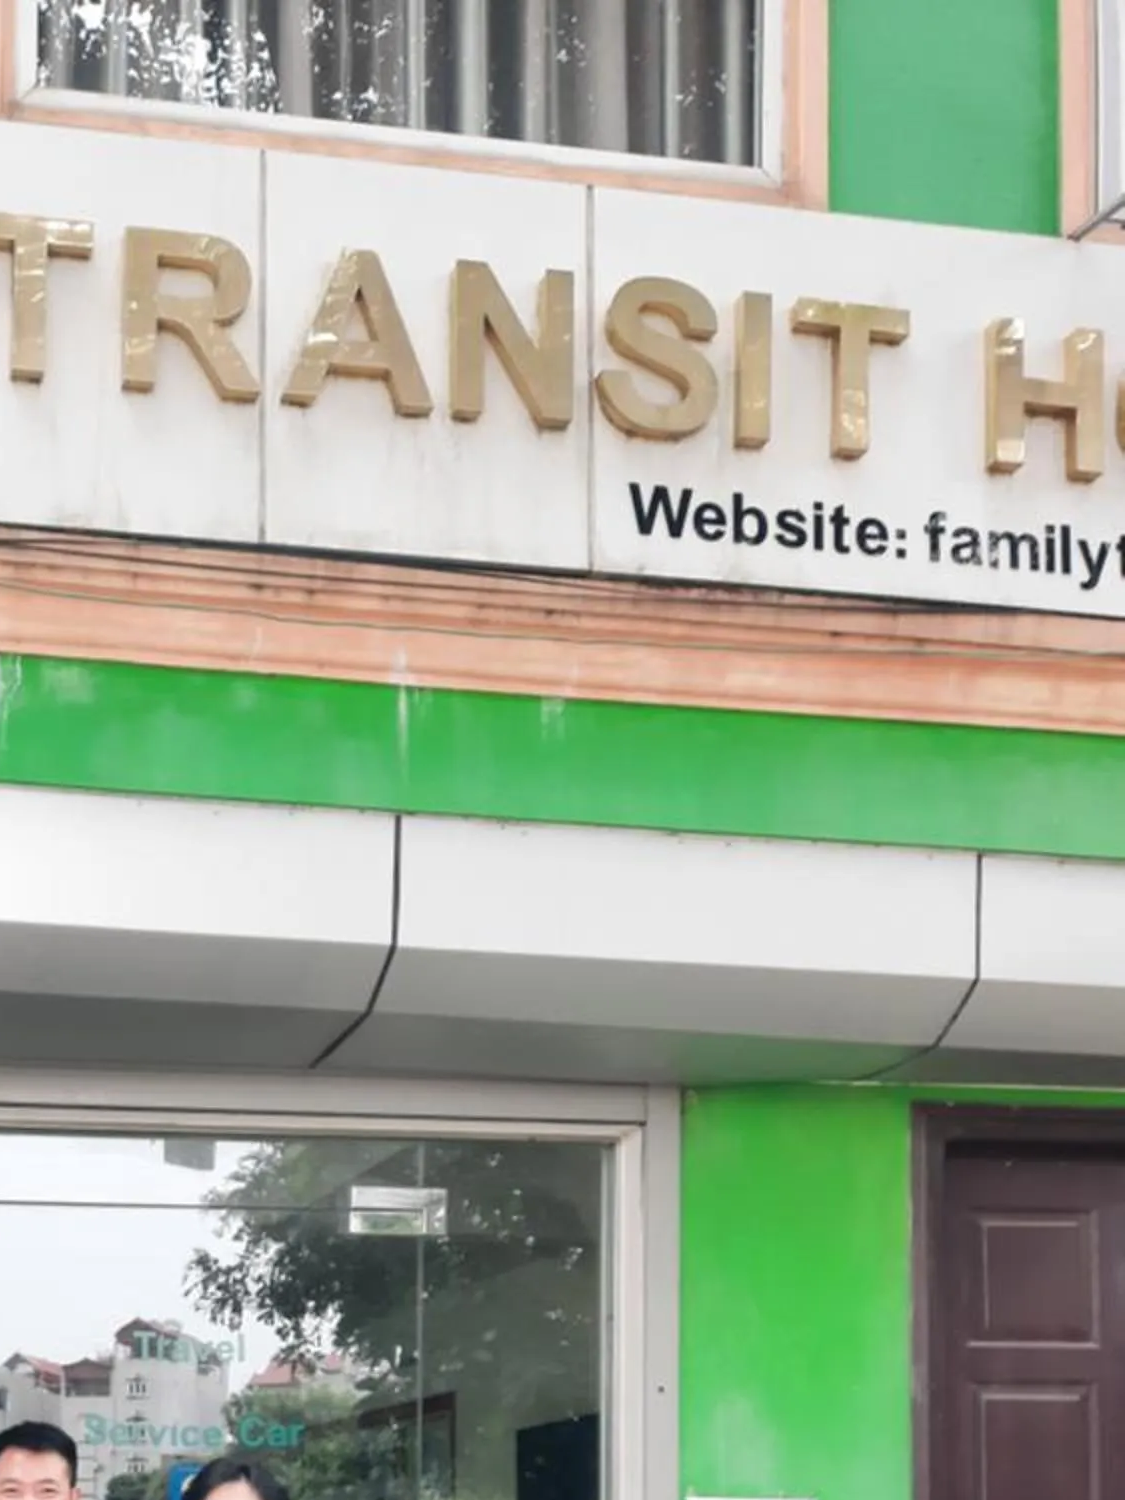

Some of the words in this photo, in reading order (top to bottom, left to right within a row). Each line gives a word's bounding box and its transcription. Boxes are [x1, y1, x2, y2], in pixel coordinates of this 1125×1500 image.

[983, 316, 1125, 484] H
[628, 481, 907, 560] Website:
[132, 1329, 246, 1363] Travel
[81, 1412, 223, 1448] Service
[238, 1411, 306, 1448] Car
